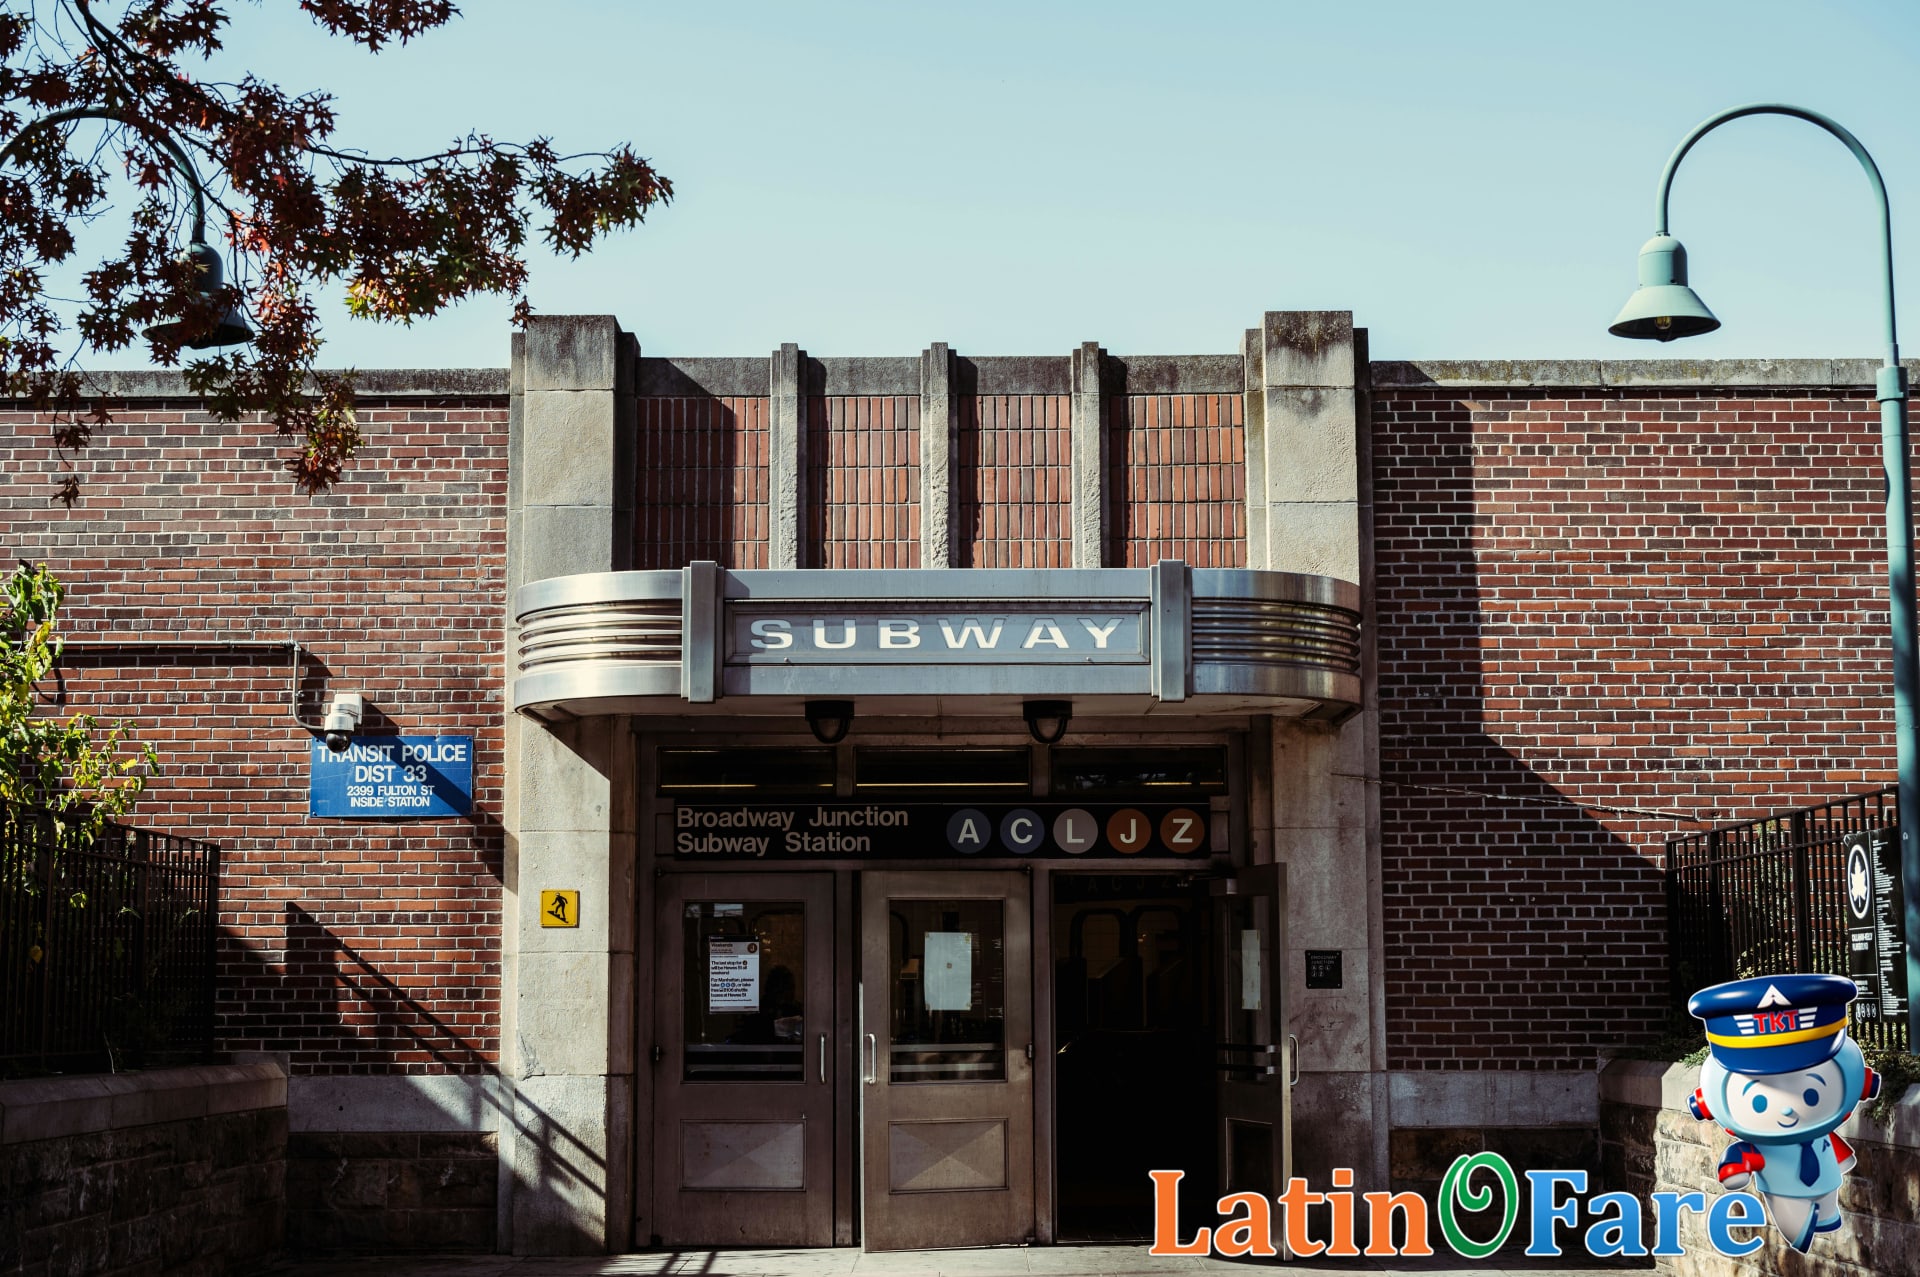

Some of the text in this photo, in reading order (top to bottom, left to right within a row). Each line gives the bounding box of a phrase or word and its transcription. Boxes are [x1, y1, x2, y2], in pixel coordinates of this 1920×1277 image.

[750, 618, 1125, 649] SUBWAY
[402, 744, 467, 763] POLICE
[355, 764, 427, 783] DIST 33
[346, 785, 435, 797] 2399 FULTON ST
[350, 796, 430, 808] INSIDE STATION
[676, 806, 909, 832] Broadway Junction
[957, 817, 1193, 844] A C L J Z
[676, 831, 871, 857] Subway Station
